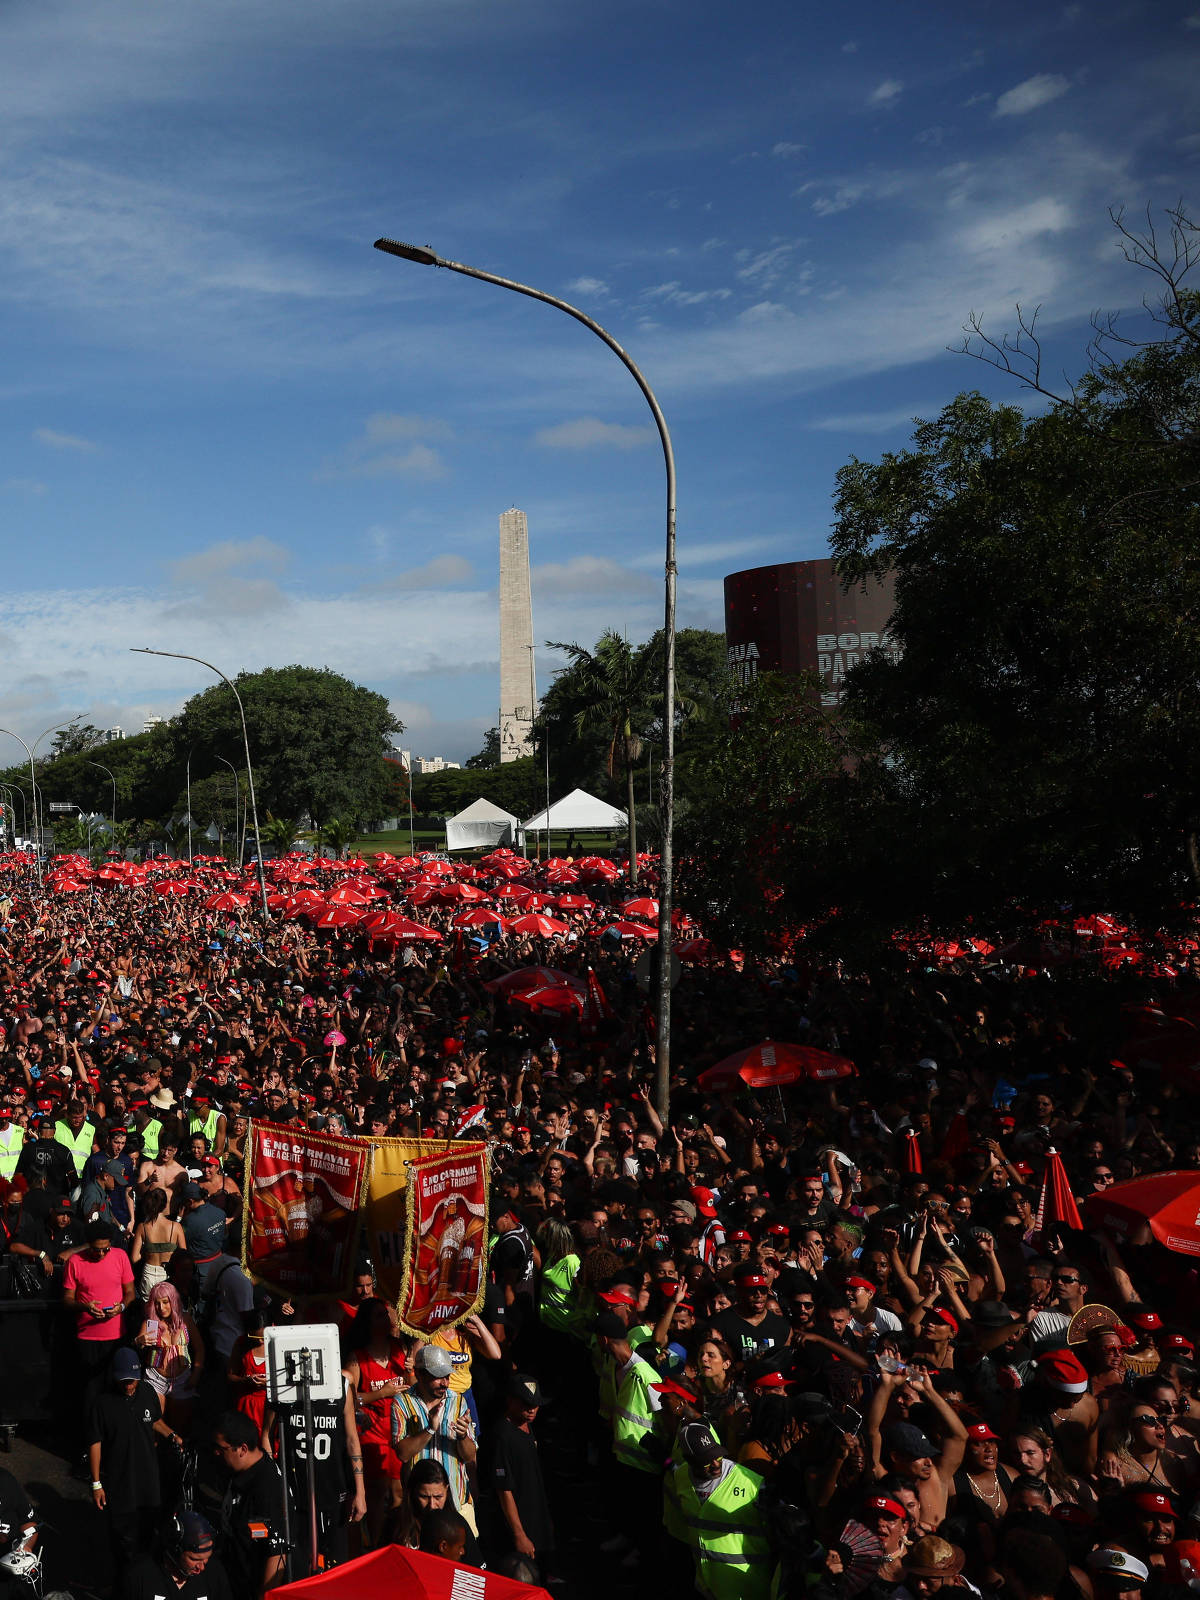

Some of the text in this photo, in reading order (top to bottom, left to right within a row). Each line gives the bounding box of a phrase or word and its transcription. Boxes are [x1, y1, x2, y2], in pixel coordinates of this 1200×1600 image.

[262, 1147, 275, 1158] QUE
[281, 1151, 301, 1164] GENTE
[309, 1157, 350, 1177] TRANSBORDA
[263, 1139, 351, 1167] É NO CARNAVAL
[422, 1165, 478, 1188] É NO CARNAVAL
[289, 1415, 338, 1429] NEW YORK
[295, 1432, 332, 1460] 30
[733, 1486, 746, 1498] 61
